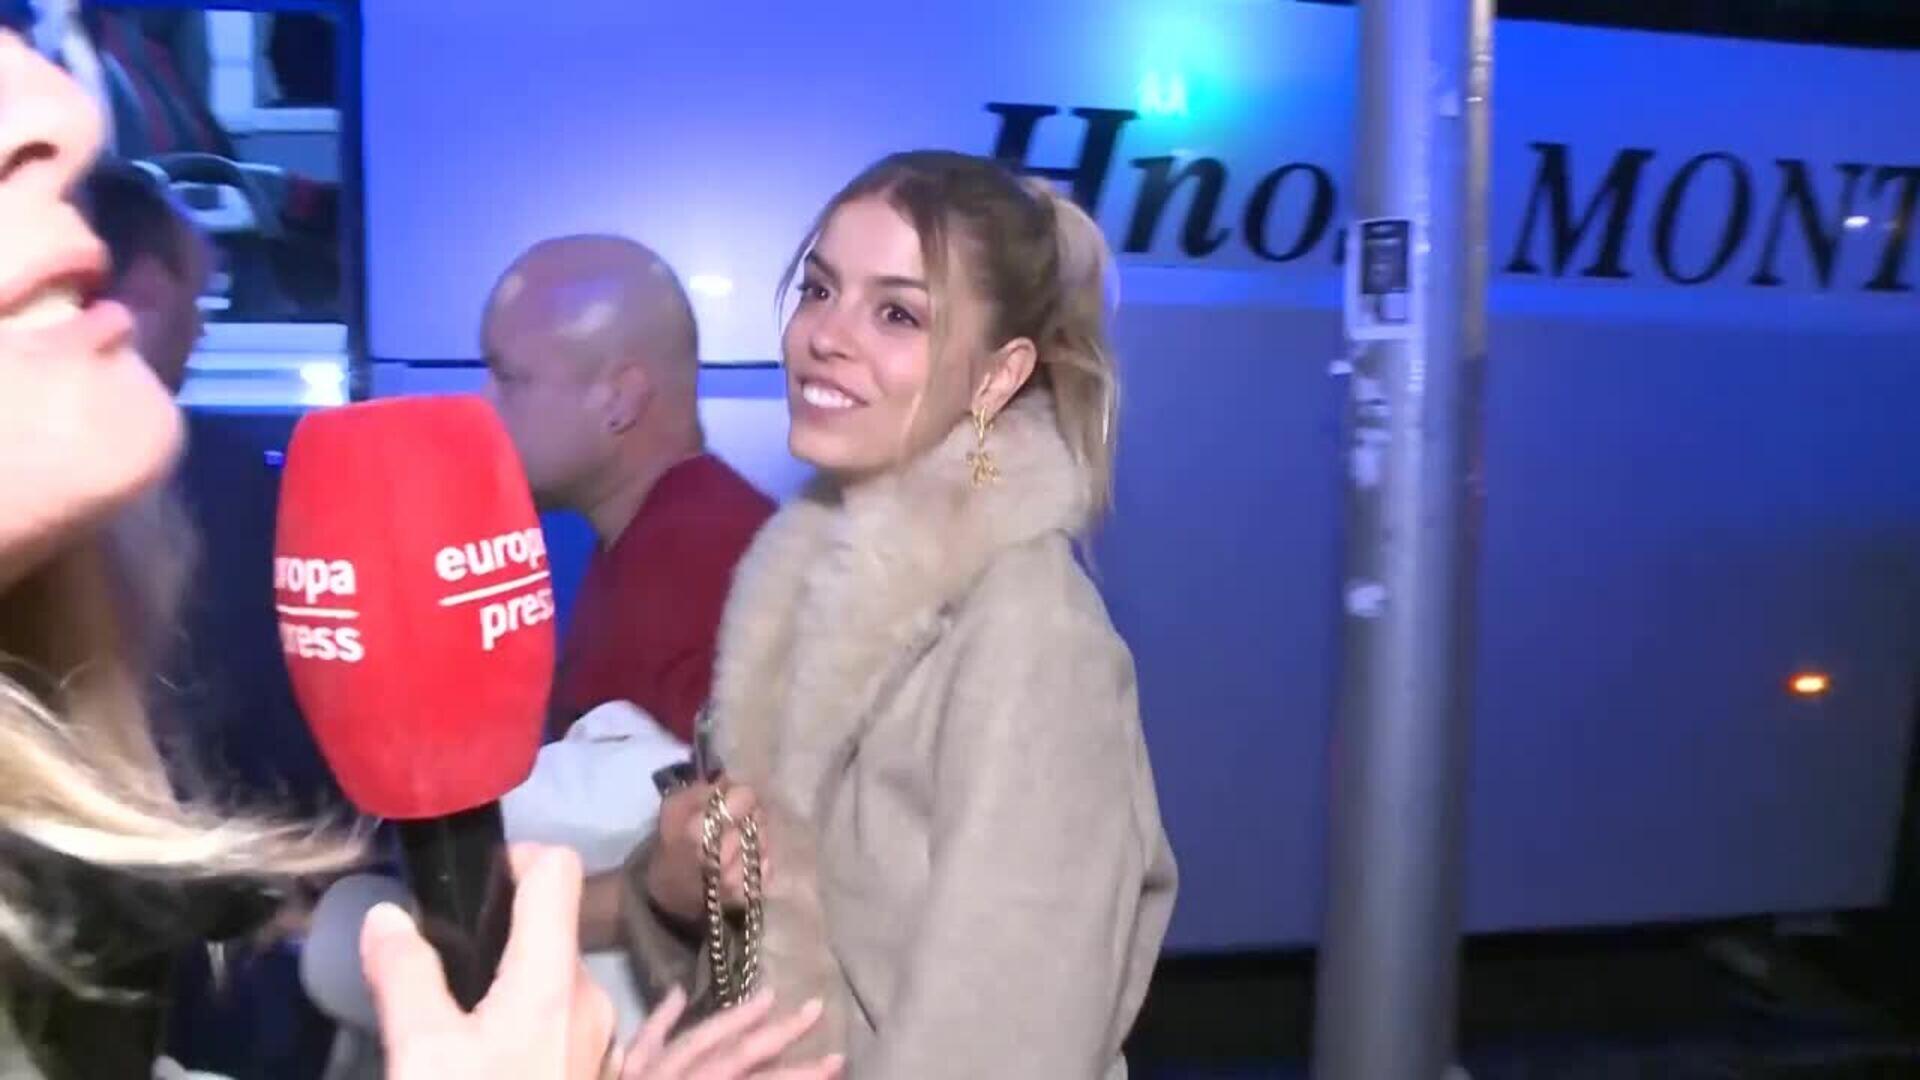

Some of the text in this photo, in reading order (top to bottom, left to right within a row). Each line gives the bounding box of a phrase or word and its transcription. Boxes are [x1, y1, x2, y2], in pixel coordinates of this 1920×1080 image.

[986, 102, 1348, 265] Hno
[1503, 140, 1920, 292] MONT
[275, 557, 356, 604] ropa
[435, 527, 547, 582] europ
[280, 622, 365, 663] ress
[480, 588, 555, 651] pres
